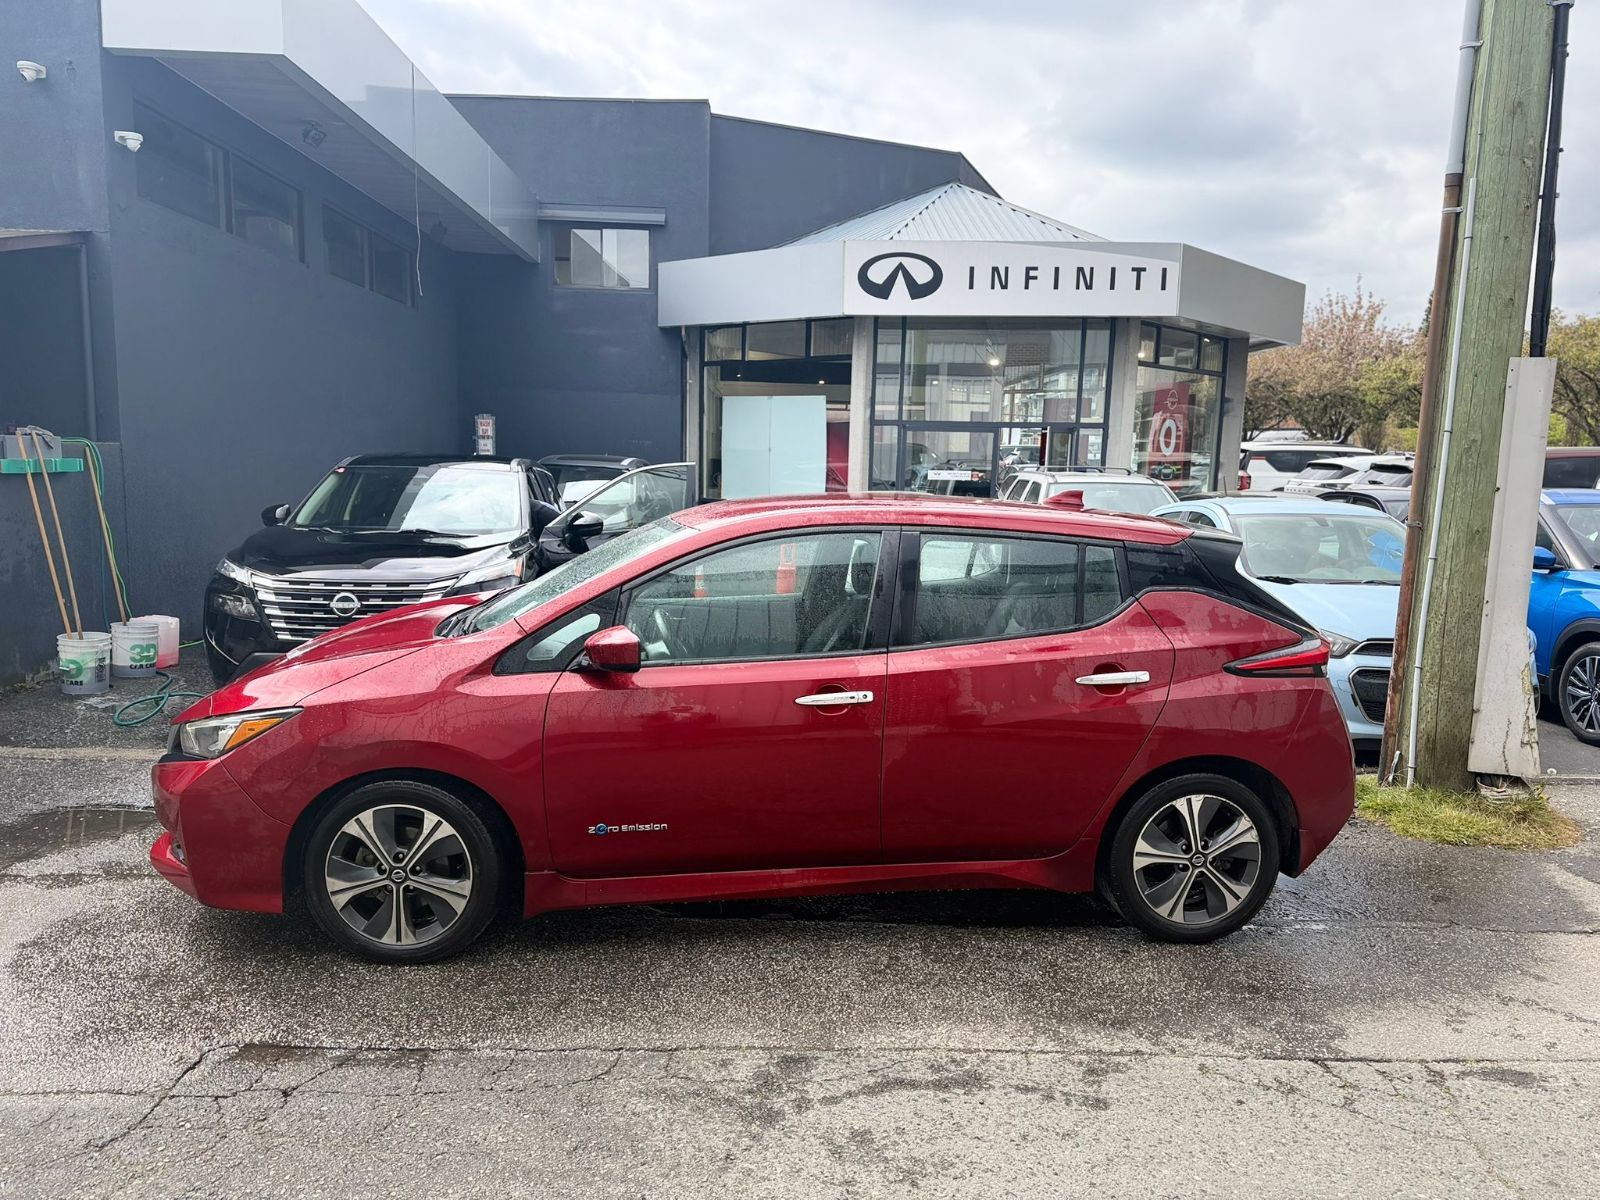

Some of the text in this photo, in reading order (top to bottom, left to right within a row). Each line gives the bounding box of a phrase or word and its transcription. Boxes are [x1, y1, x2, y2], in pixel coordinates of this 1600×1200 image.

[968, 265, 1168, 291] INFINITI
[129, 643, 157, 663] 3D
[63, 658, 84, 679] D
